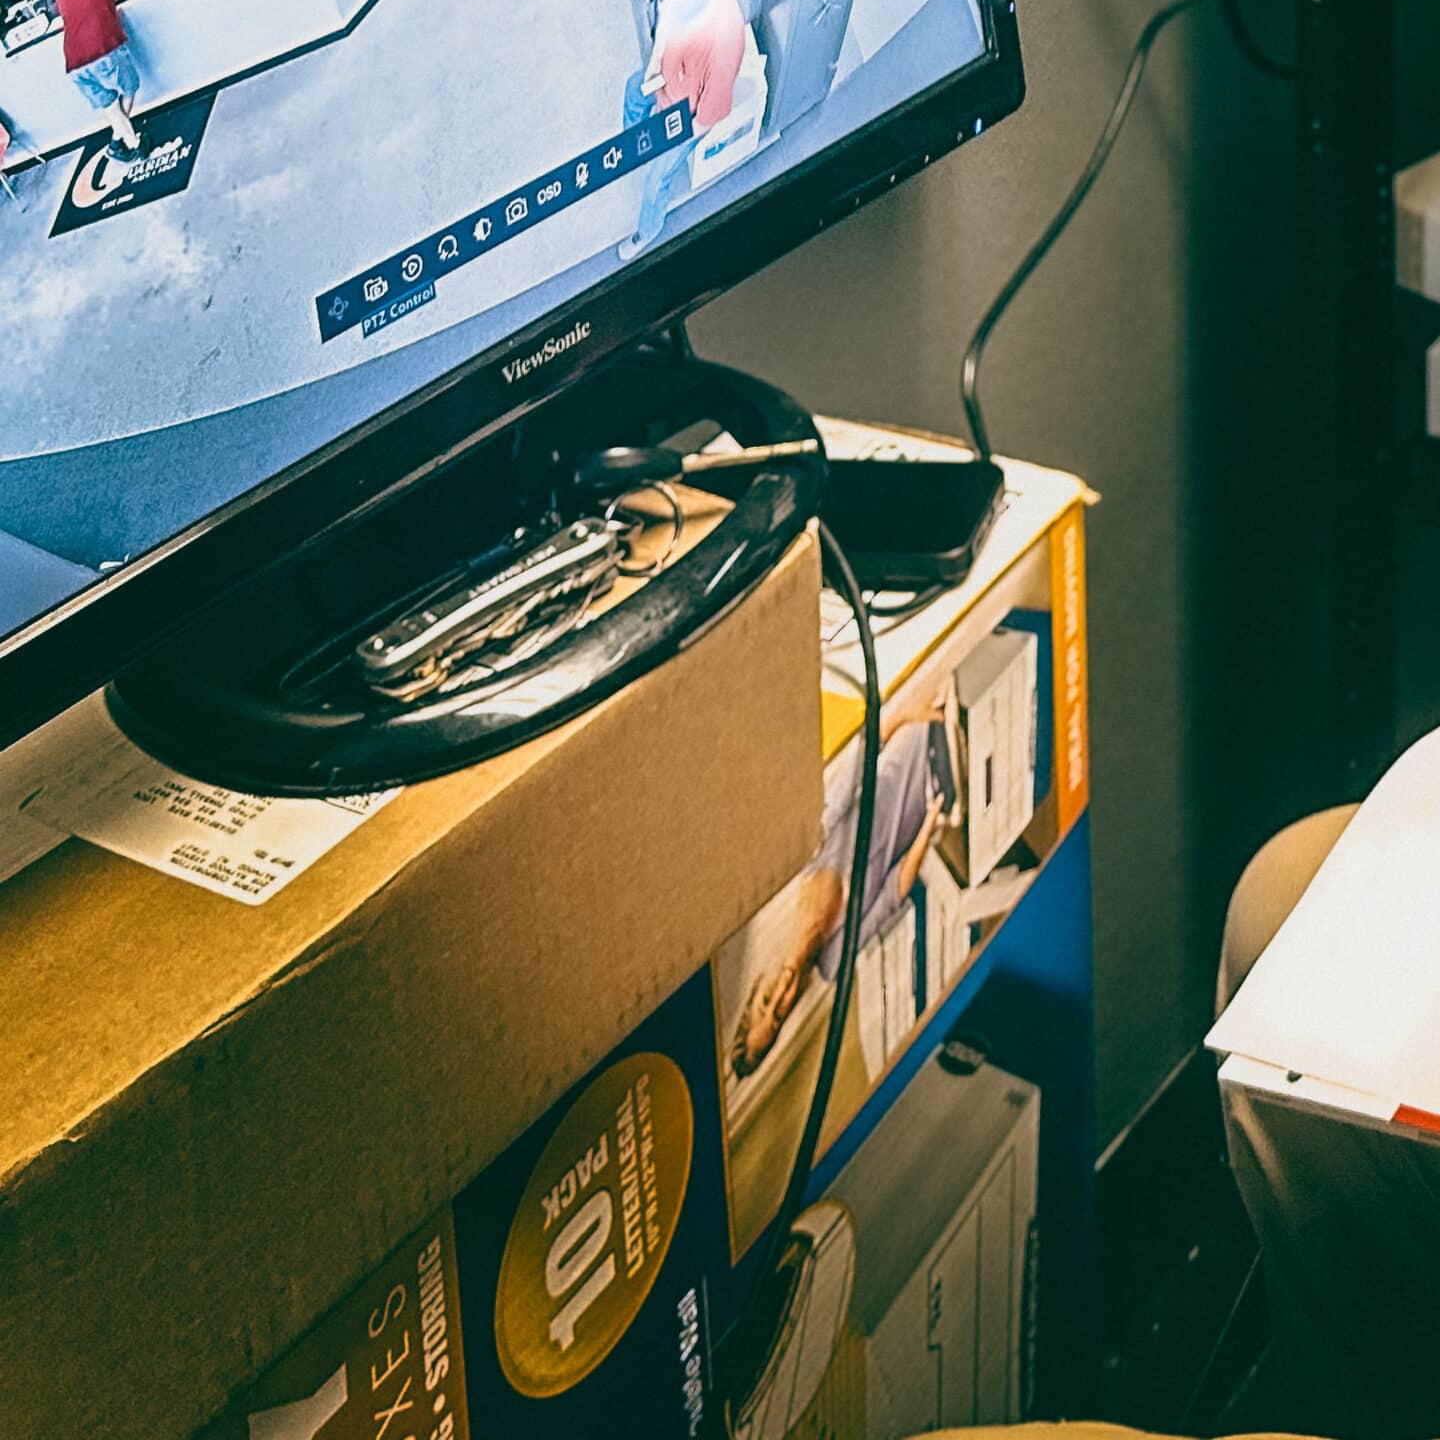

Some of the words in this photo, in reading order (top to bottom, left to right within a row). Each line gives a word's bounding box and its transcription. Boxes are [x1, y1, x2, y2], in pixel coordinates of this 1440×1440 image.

[537, 181, 562, 205] OSD
[362, 309, 387, 333] PTZ
[390, 284, 435, 320] Control
[501, 319, 593, 385] ViewSonic
[540, 1131, 609, 1231] PACK
[615, 1088, 645, 1279] LETTER/LEGAL
[418, 1234, 450, 1392] STORING
[545, 1189, 616, 1351] 10
[368, 1284, 416, 1440] XES
[677, 1288, 699, 1361] Wall
